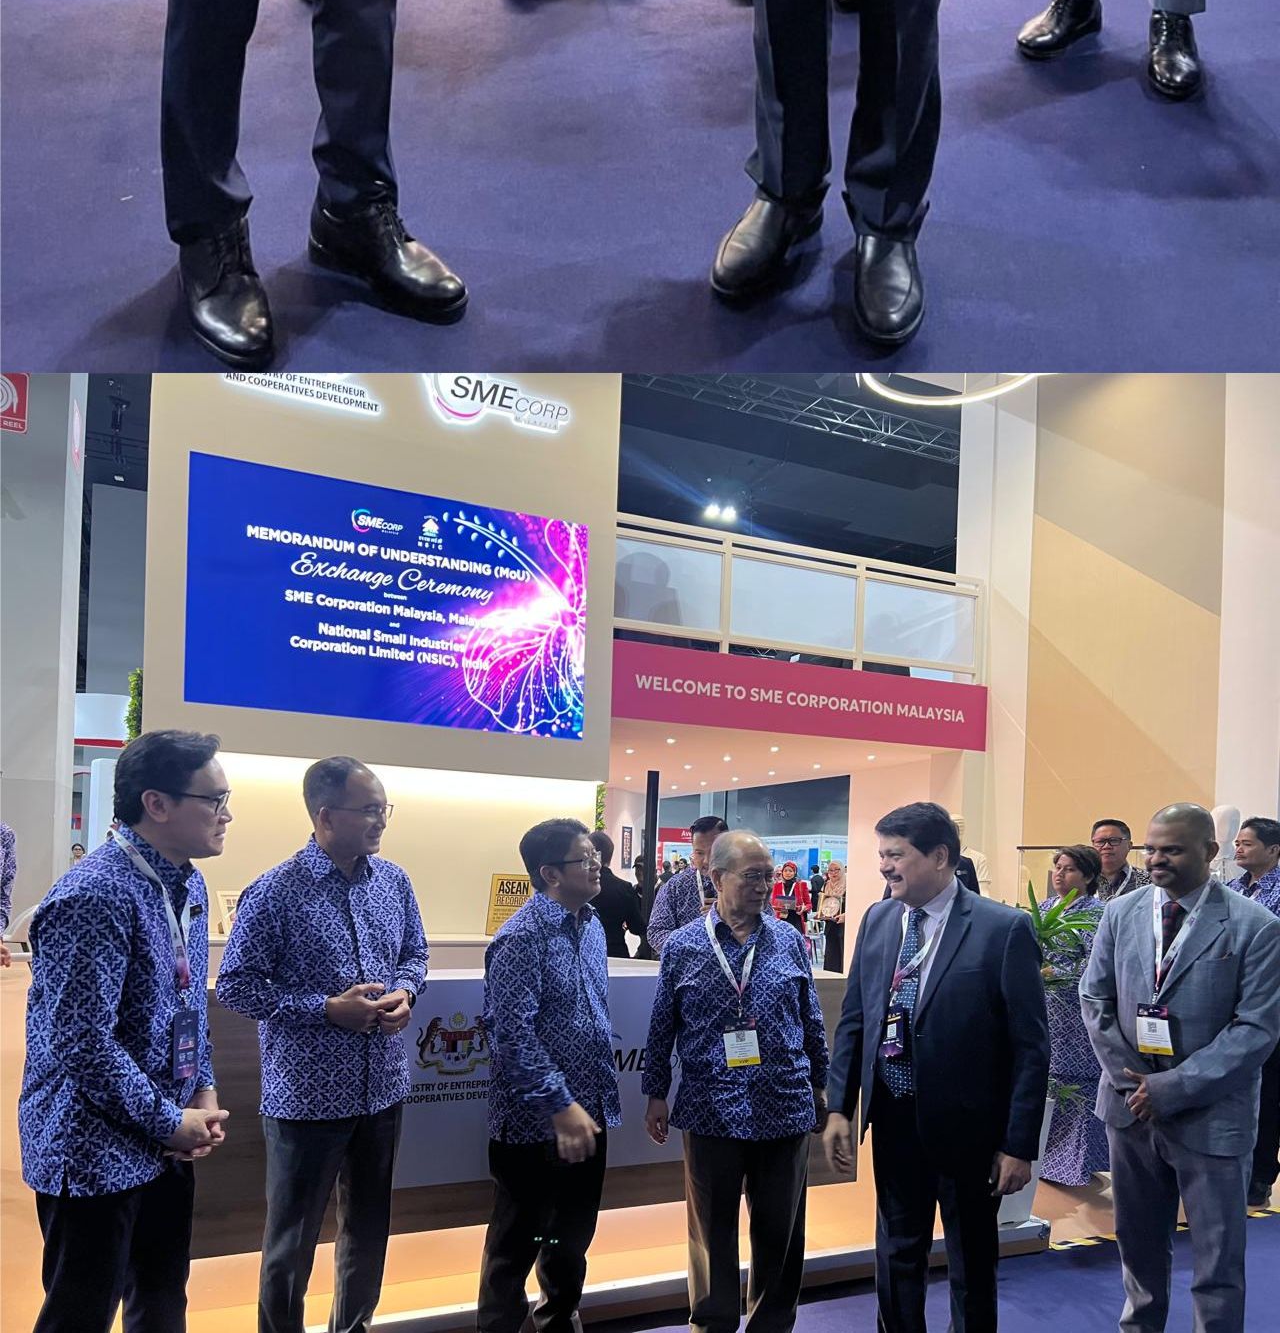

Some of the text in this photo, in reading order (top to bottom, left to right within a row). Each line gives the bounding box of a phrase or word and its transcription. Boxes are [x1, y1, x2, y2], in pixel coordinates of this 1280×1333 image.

[226, 373, 378, 412] AND COOPERATIVES DEVELOPMENT
[286, 373, 298, 382] OF
[299, 376, 365, 398] ENTREPRENEUR
[3, 420, 24, 429] REEL
[246, 525, 531, 583] MEMORANDUM OF UNDERSTANDING (MoU)
[291, 551, 494, 606] Exchange Ceremony
[285, 589, 313, 604] SME
[316, 593, 391, 615] Corporation
[393, 604, 446, 624] Malaysia,
[383, 592, 408, 601] between
[290, 635, 366, 655] Corporation
[369, 645, 414, 662] Limited
[417, 649, 458, 669] (NSIC),
[318, 622, 465, 653] National Small Industries
[635, 673, 965, 723] WELCOME TO SME CORPORATION MALAYSIA
[498, 881, 530, 895] ASEAN
[402, 1092, 465, 1104] COOPERATIVES
[437, 1082, 450, 1091] OF
